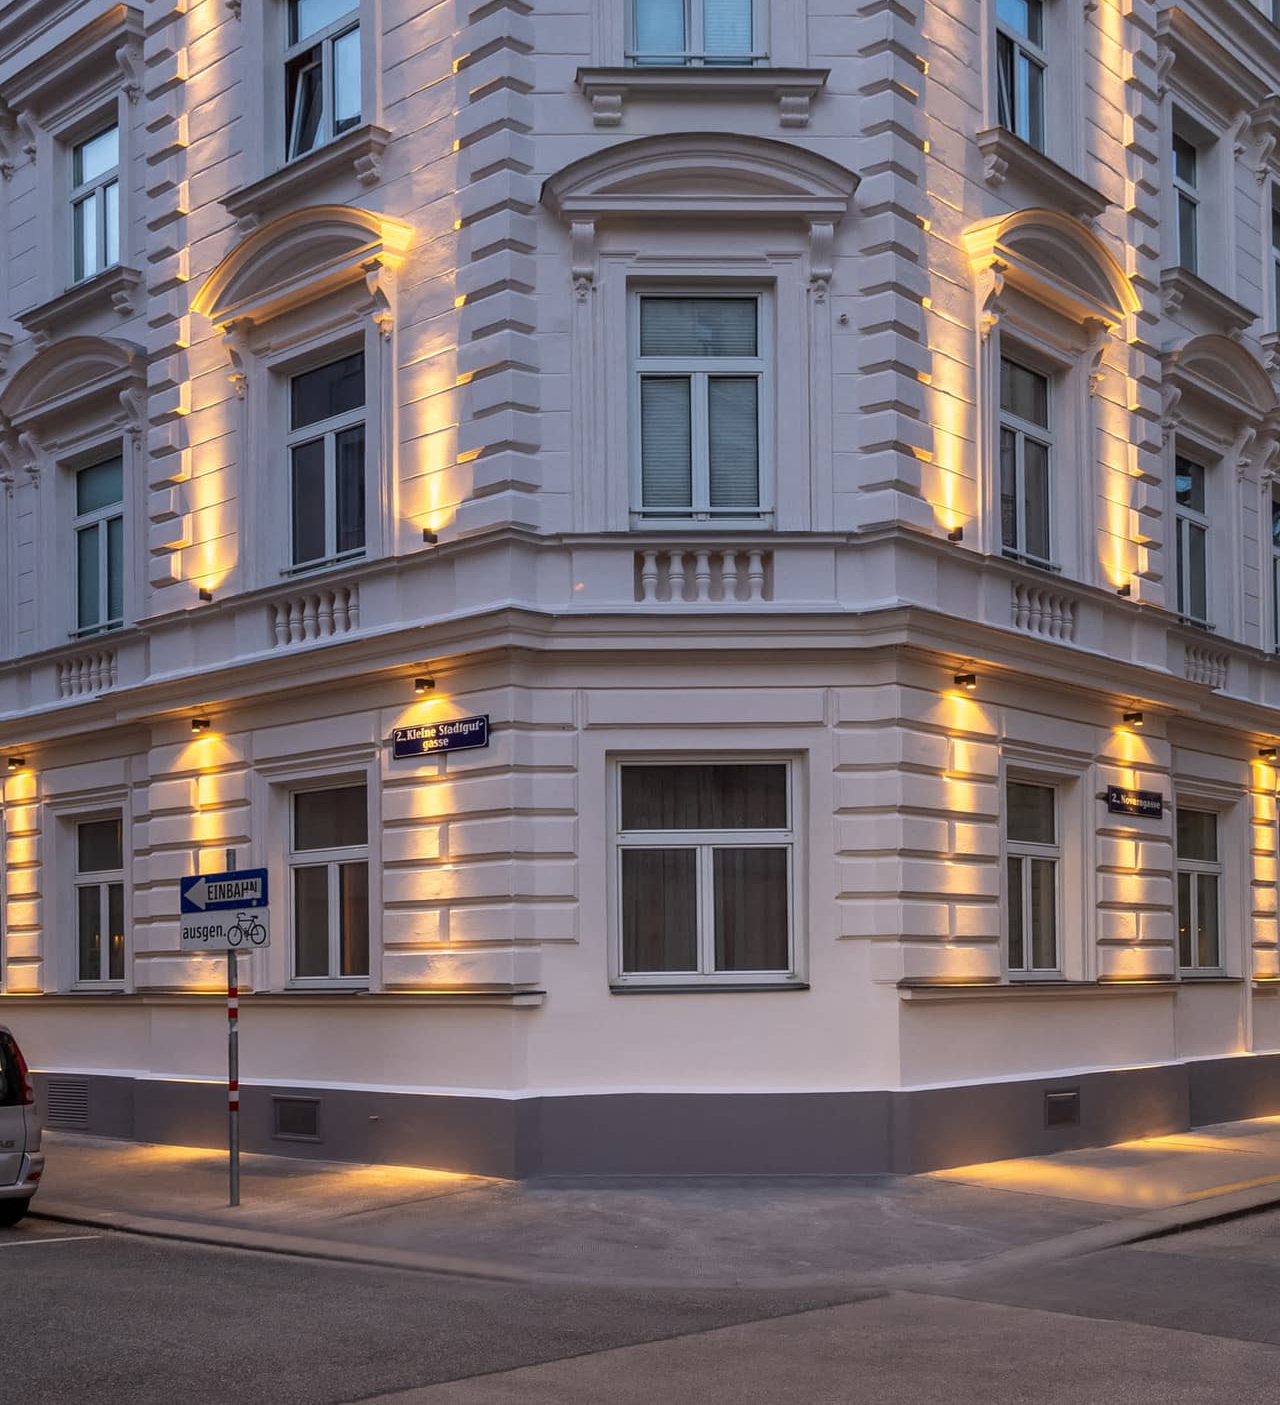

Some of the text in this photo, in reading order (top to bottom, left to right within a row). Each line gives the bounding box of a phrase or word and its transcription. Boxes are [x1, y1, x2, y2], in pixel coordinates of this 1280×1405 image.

[407, 727, 437, 741] Kleine
[439, 719, 484, 735] Stadtgut-
[422, 737, 449, 752] gasse
[207, 880, 258, 901] EINBAHN
[183, 924, 227, 942] ausgen.
